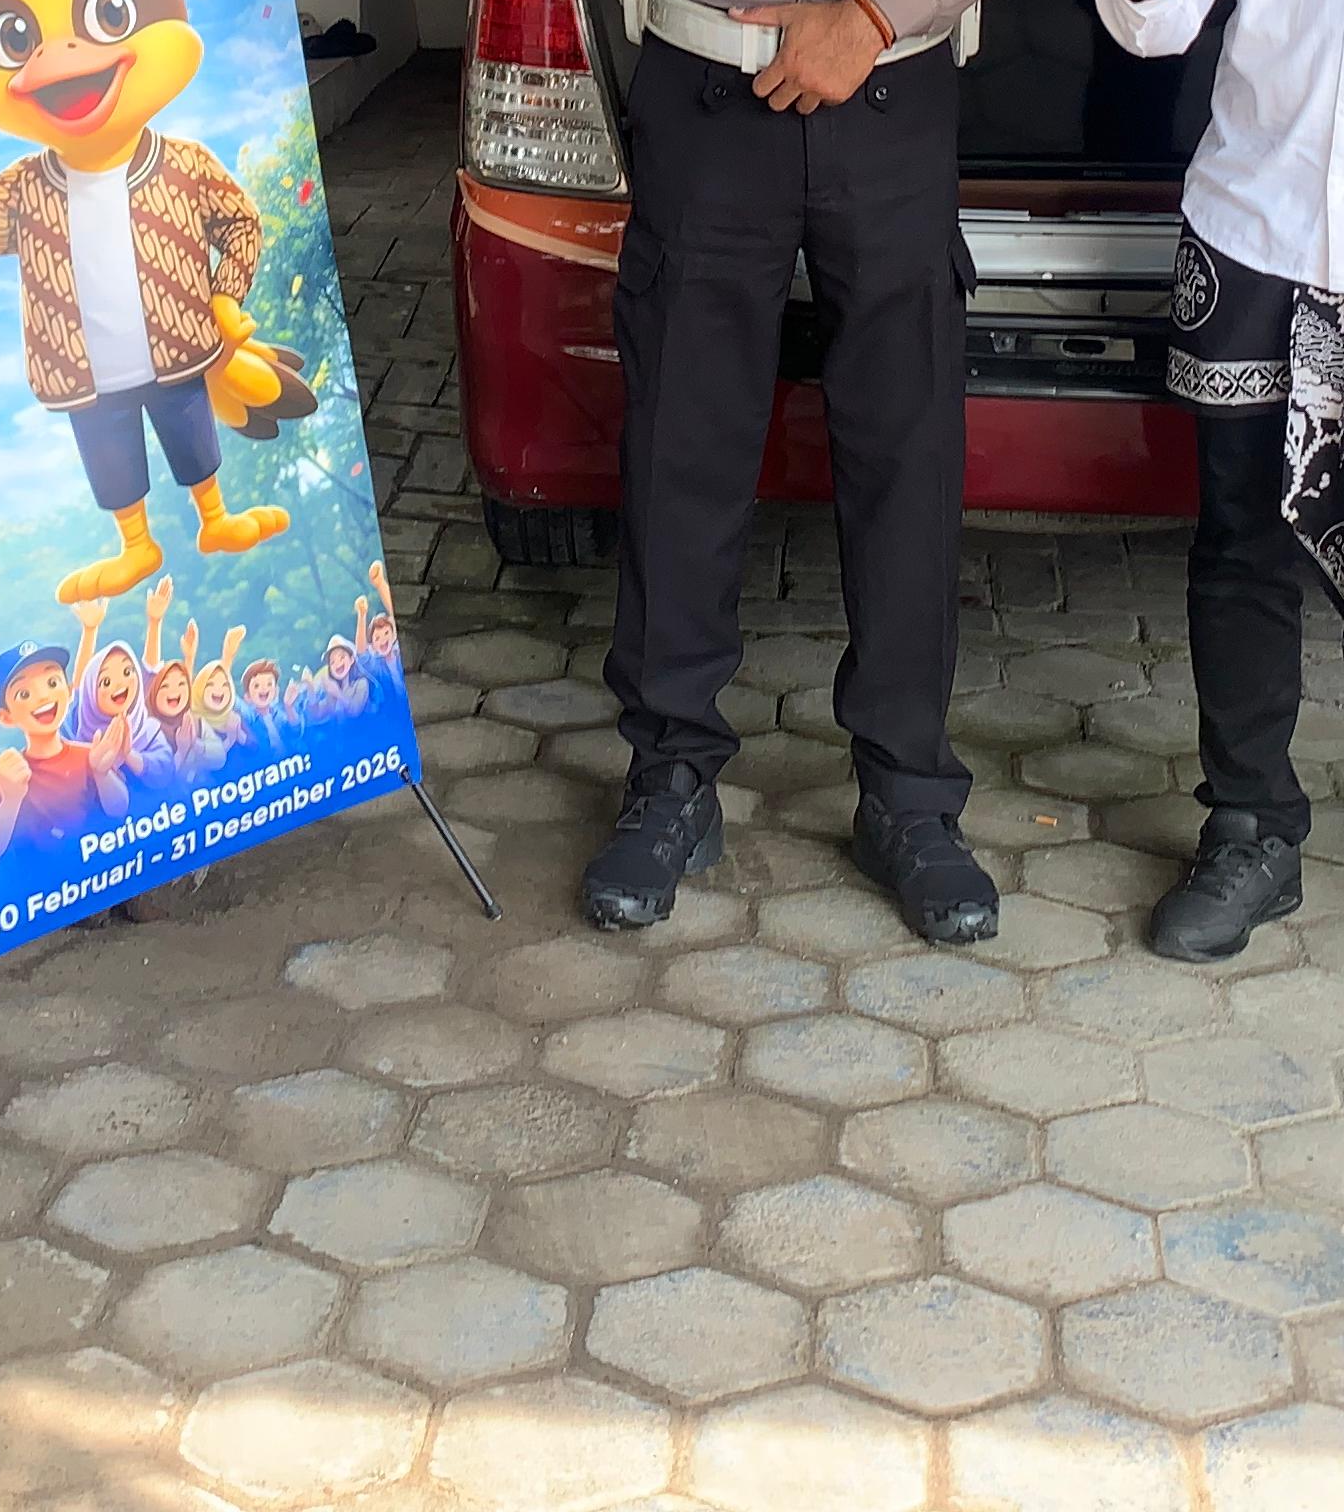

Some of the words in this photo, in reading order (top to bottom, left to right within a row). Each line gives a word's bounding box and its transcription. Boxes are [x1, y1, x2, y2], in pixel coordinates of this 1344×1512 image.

[27, 850, 144, 922] Februari
[171, 830, 196, 861] 31
[205, 777, 335, 848] Desember
[341, 745, 401, 792] 2026
[80, 802, 187, 863] Periode
[192, 753, 312, 817] Program:
